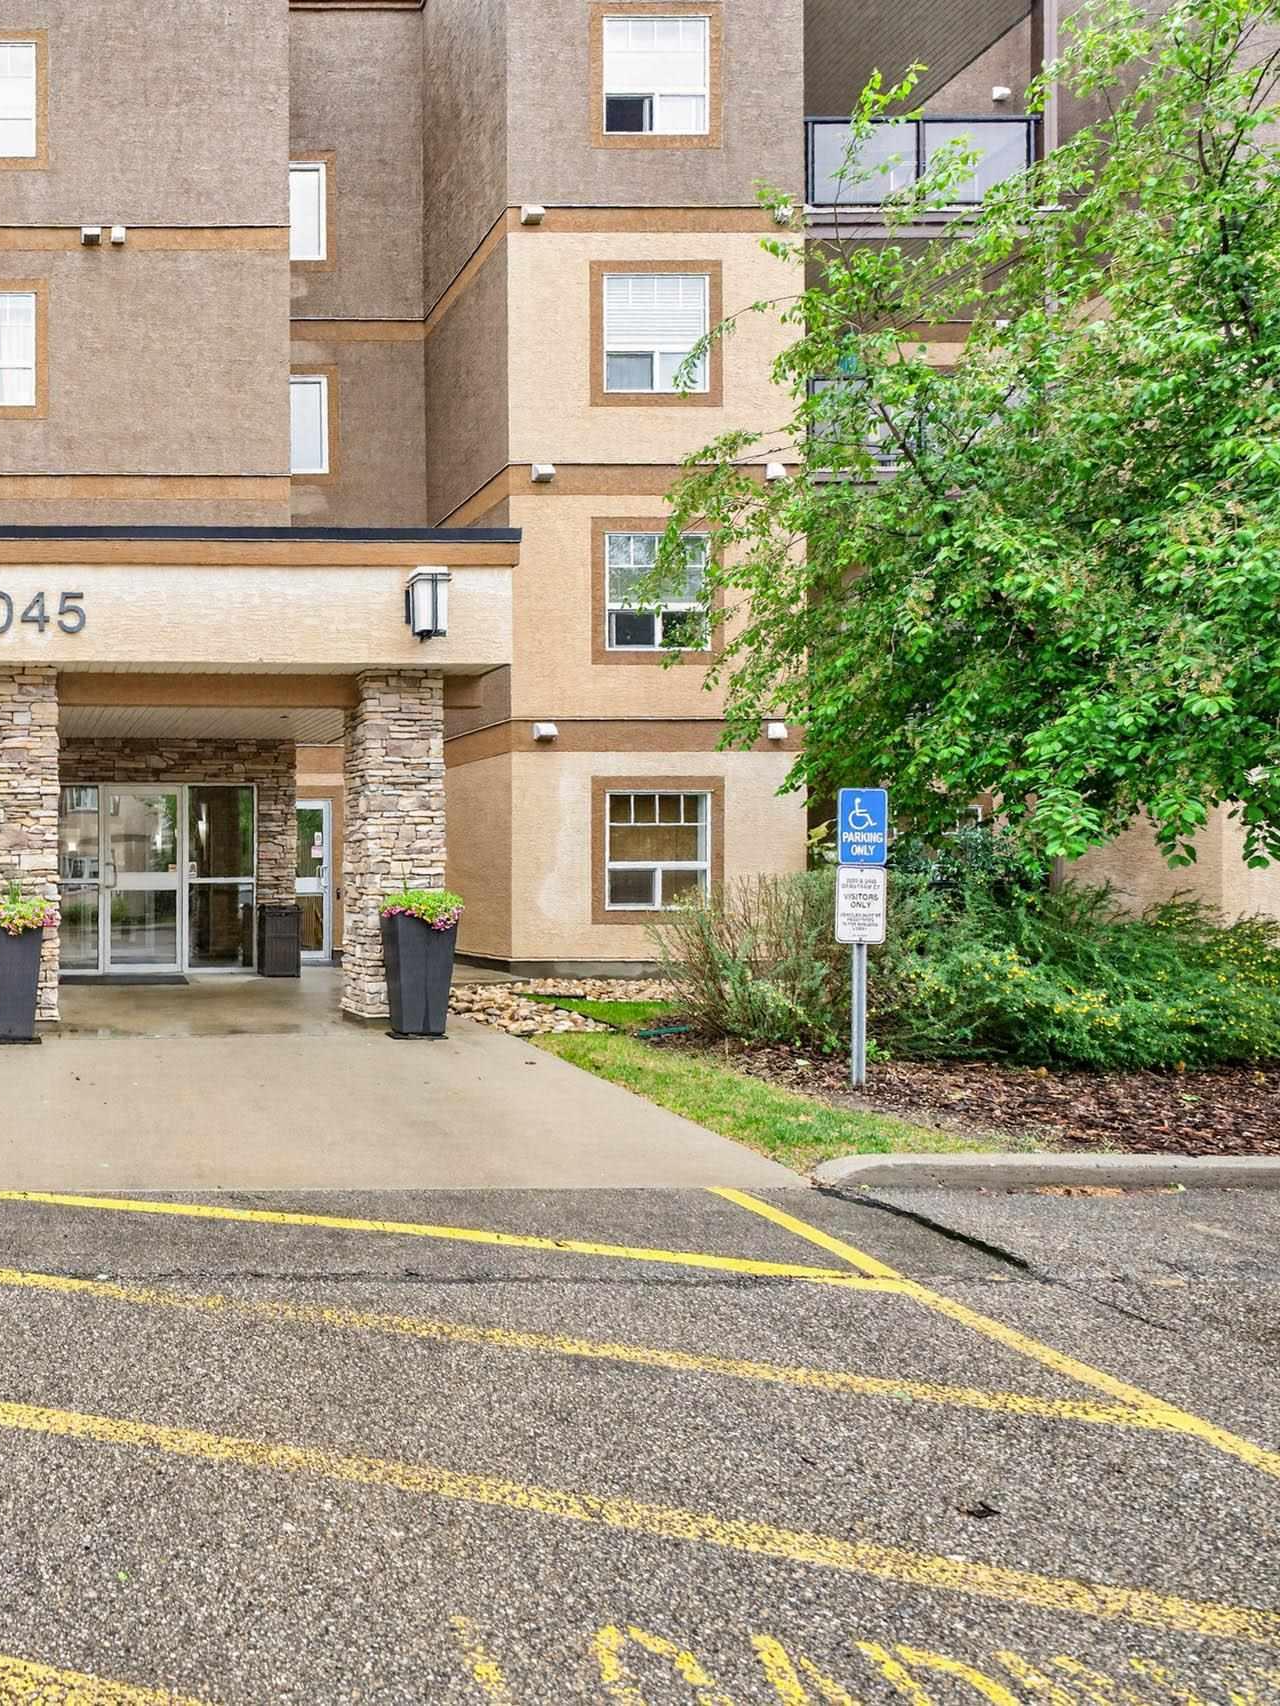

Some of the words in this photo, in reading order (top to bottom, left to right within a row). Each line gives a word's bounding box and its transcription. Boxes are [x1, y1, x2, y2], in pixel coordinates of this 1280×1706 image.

[842, 831, 883, 843] PARKING
[850, 844, 876, 856] ONLY
[844, 893, 879, 901] VISITORS
[850, 901, 871, 909] ONLY
